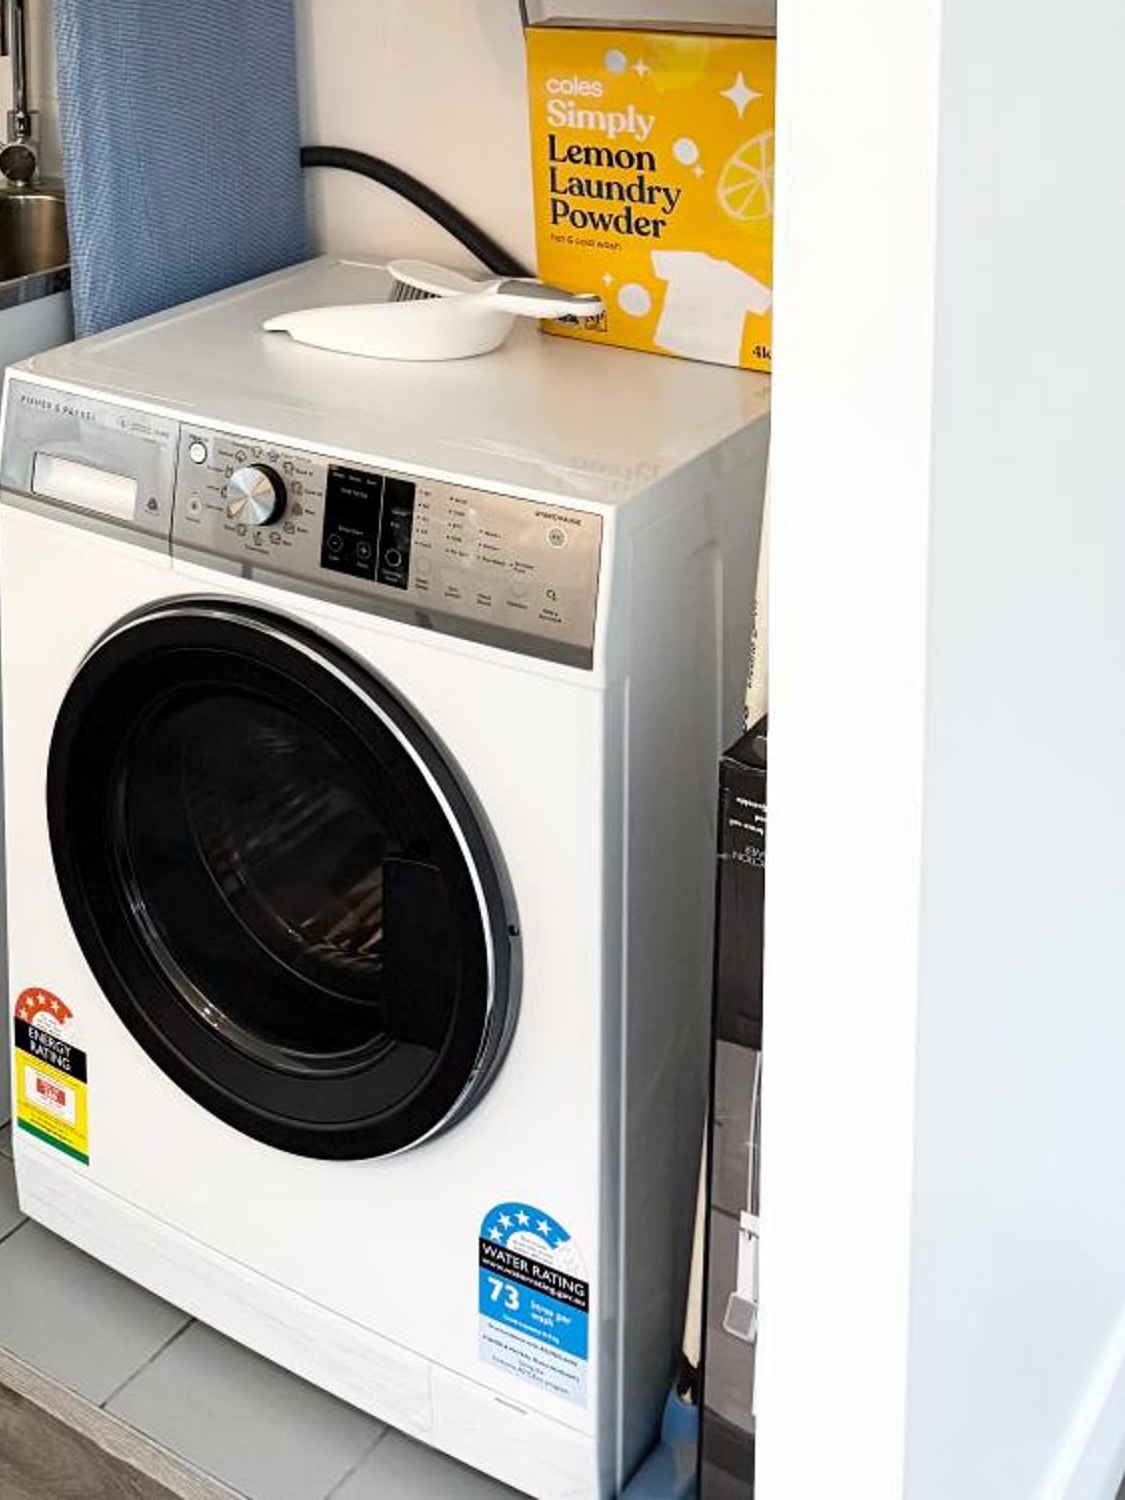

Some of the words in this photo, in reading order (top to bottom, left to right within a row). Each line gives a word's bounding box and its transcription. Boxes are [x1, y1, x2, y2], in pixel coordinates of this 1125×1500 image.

[546, 76, 603, 97] coles
[547, 99, 655, 142] Simply
[548, 133, 656, 172] Lemon
[549, 167, 682, 214] Laundry
[551, 197, 667, 238] Powder
[28, 1026, 72, 1055] ENERGY
[30, 1040, 72, 1072] RATING
[482, 1242, 529, 1273] WATER
[532, 1265, 585, 1297] RATING
[487, 1276, 520, 1311] 73
